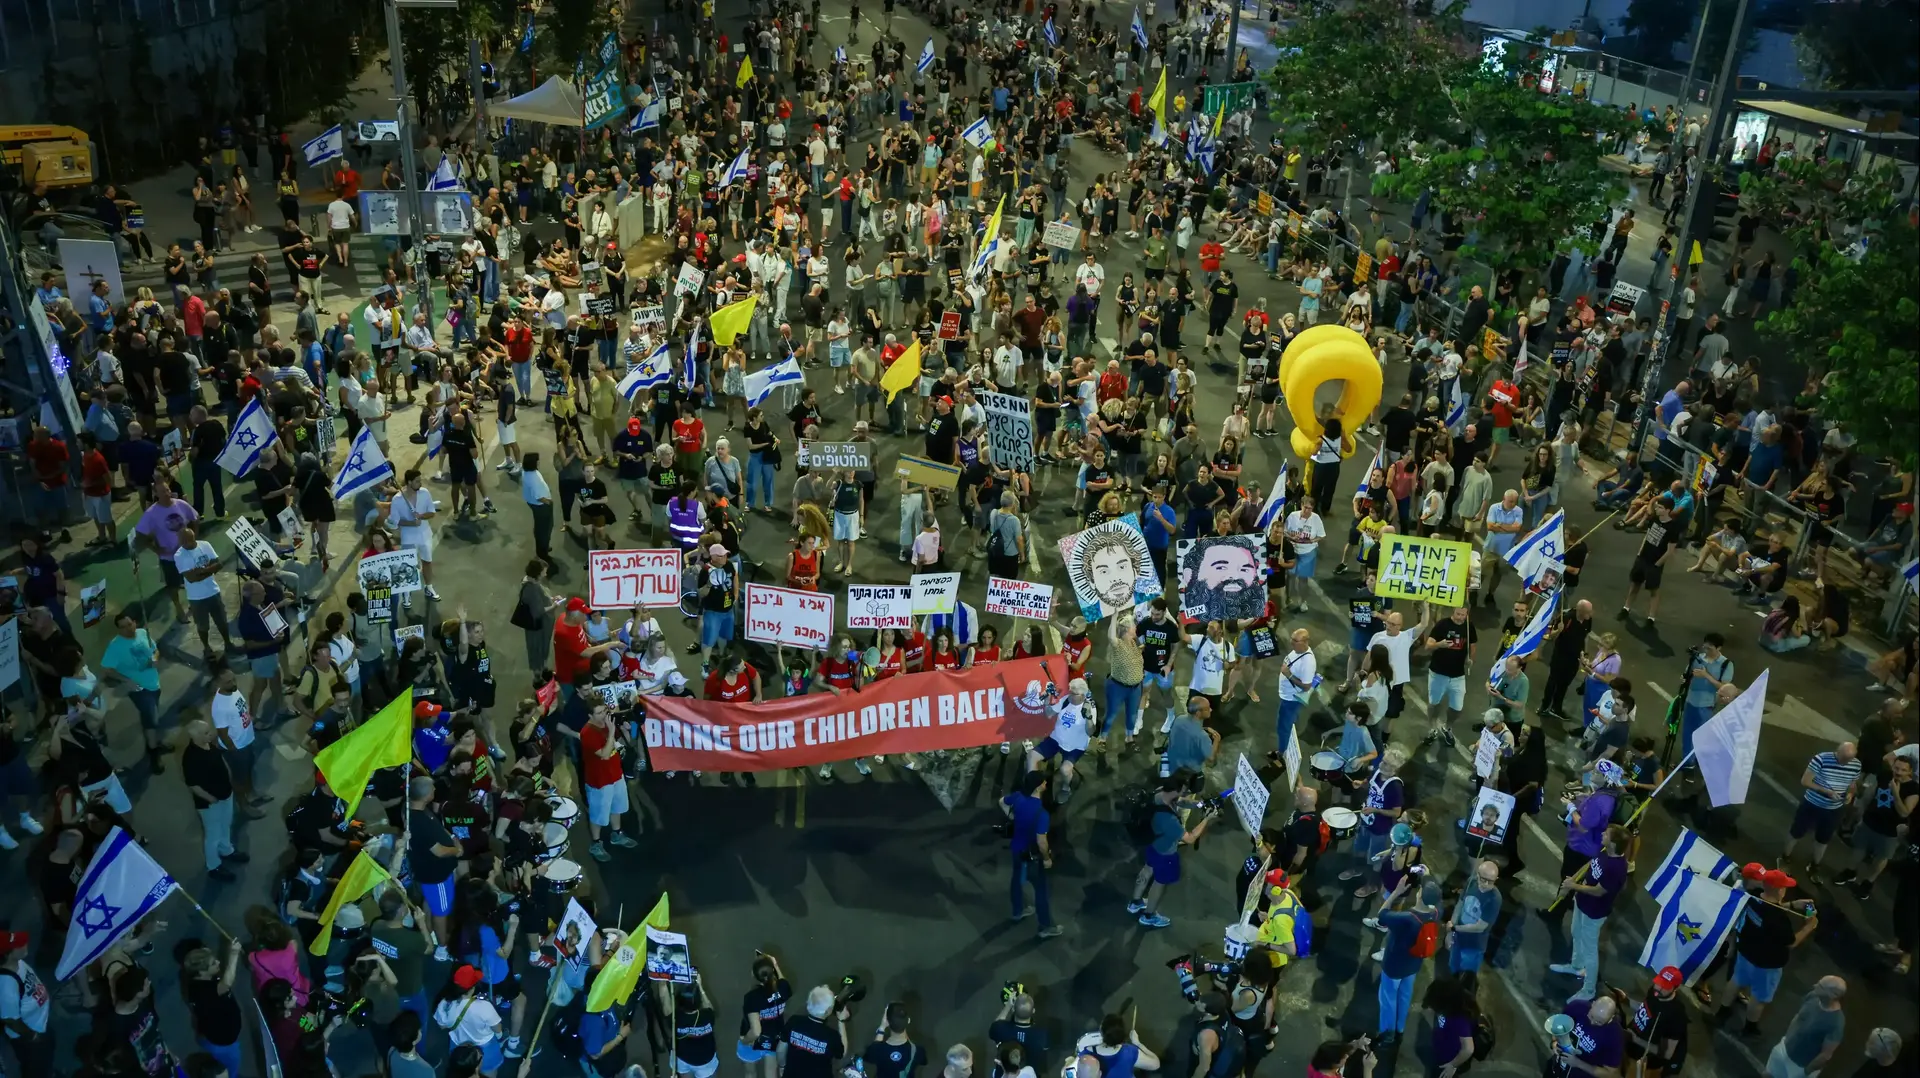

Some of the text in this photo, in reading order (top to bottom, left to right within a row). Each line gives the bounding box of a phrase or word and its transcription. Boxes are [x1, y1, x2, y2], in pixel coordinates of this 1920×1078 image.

[824, 444, 856, 454] מה עם
[812, 454, 868, 467] החטופים
[1390, 561, 1446, 580] THEM
[850, 588, 912, 600] מי הבא בתור
[988, 588, 1051, 604] MAKE THE ONLY
[752, 594, 825, 612] אמא עינב
[1000, 597, 1048, 610] MORAL CALL
[986, 604, 1048, 618] FREE THEM ALL
[1186, 606, 1204, 618] איתן
[850, 616, 909, 628] ומי בתור הבא
[752, 619, 826, 642] מחכה למתן
[644, 687, 1005, 752] BRING OUR CHILDREN BACK
